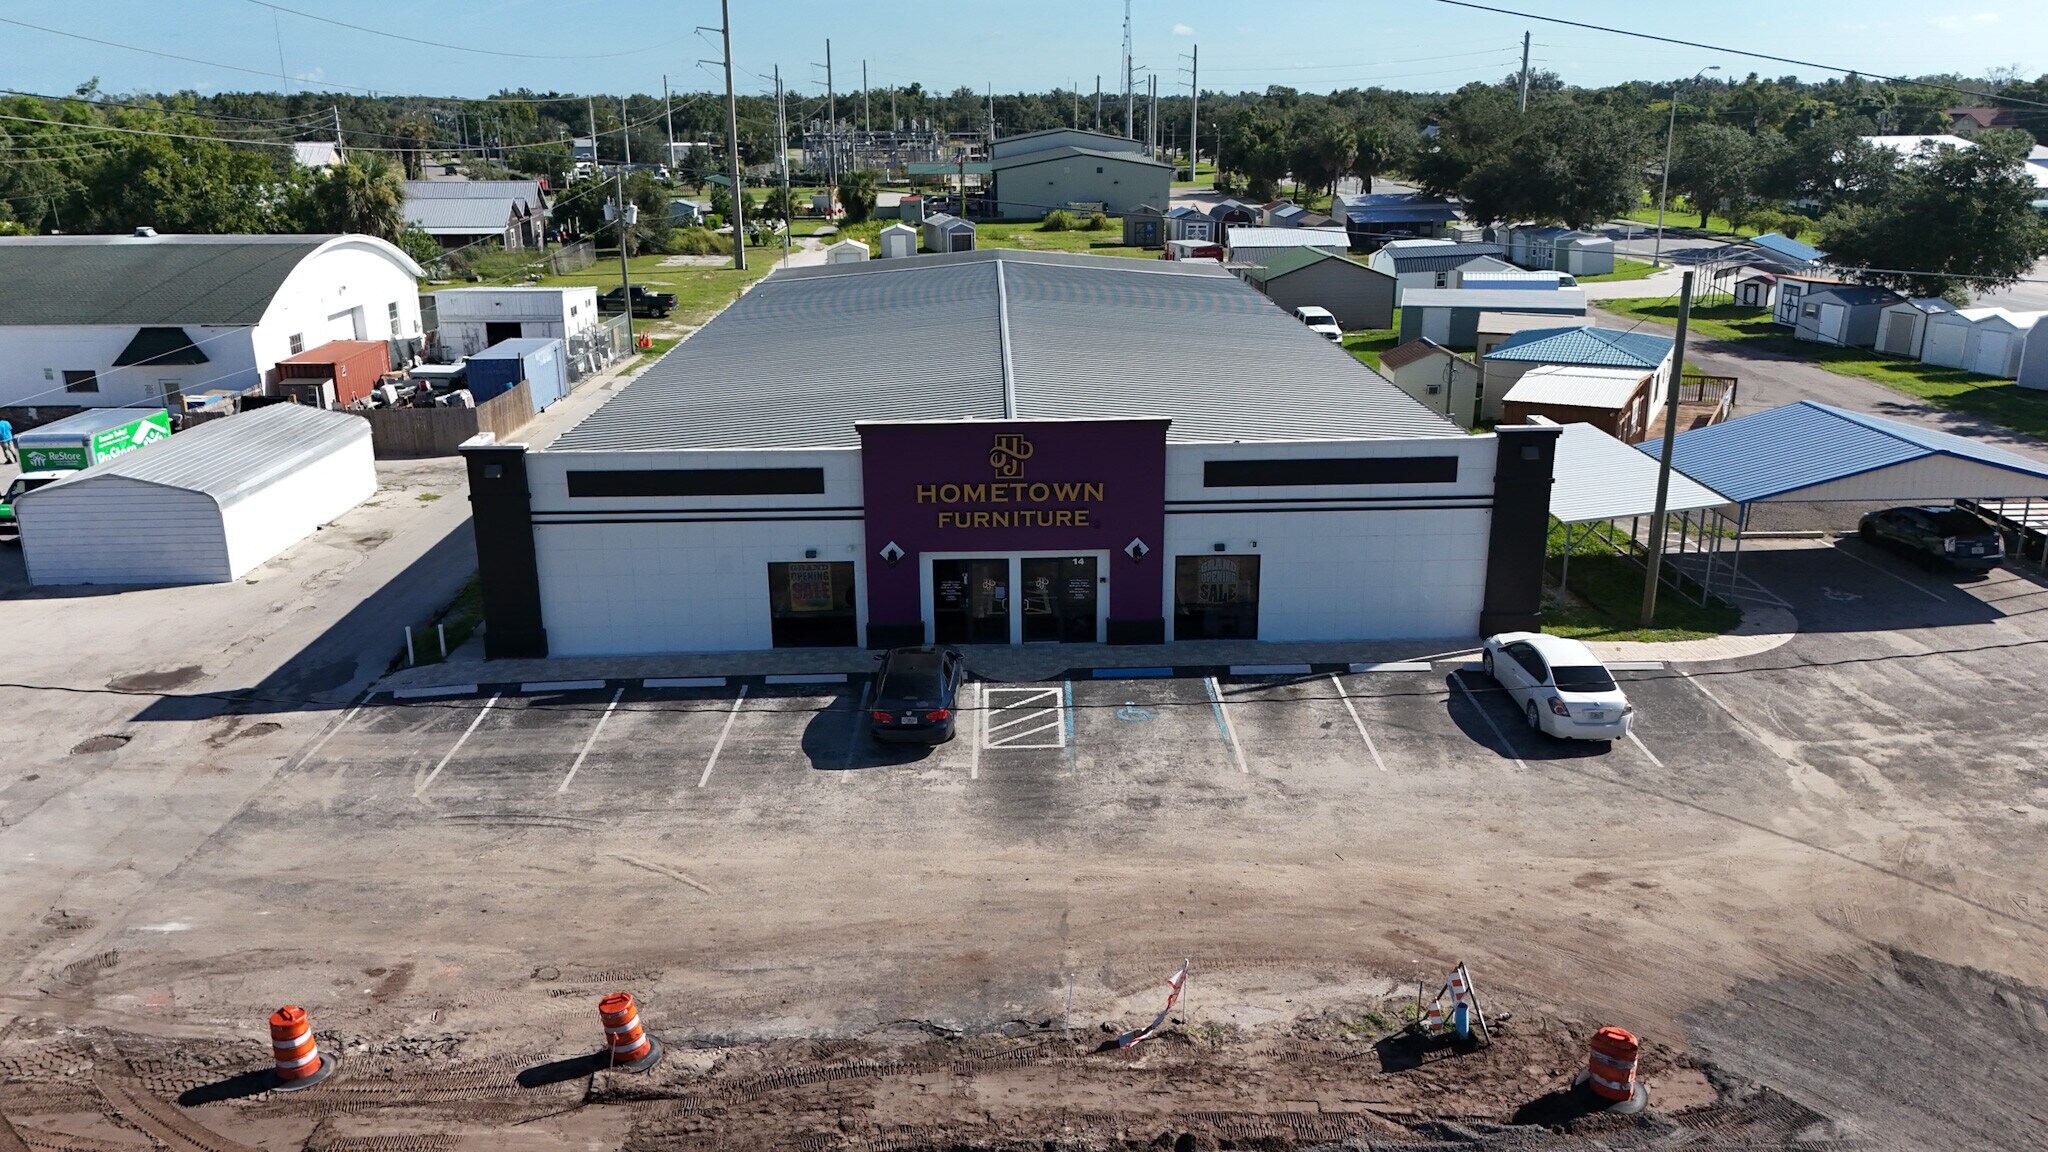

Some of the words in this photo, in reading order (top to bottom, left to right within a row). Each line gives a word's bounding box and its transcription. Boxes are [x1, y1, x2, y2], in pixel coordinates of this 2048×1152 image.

[49, 451, 81, 461] ReStore
[917, 482, 1104, 503] HOMETOWN
[938, 510, 1090, 528] FURNITURE
[1072, 557, 1085, 566] 14
[1201, 557, 1237, 573] GRAND
[791, 571, 830, 581] OPENING
[1200, 571, 1236, 583] OPENING
[1200, 583, 1237, 602] SALE
